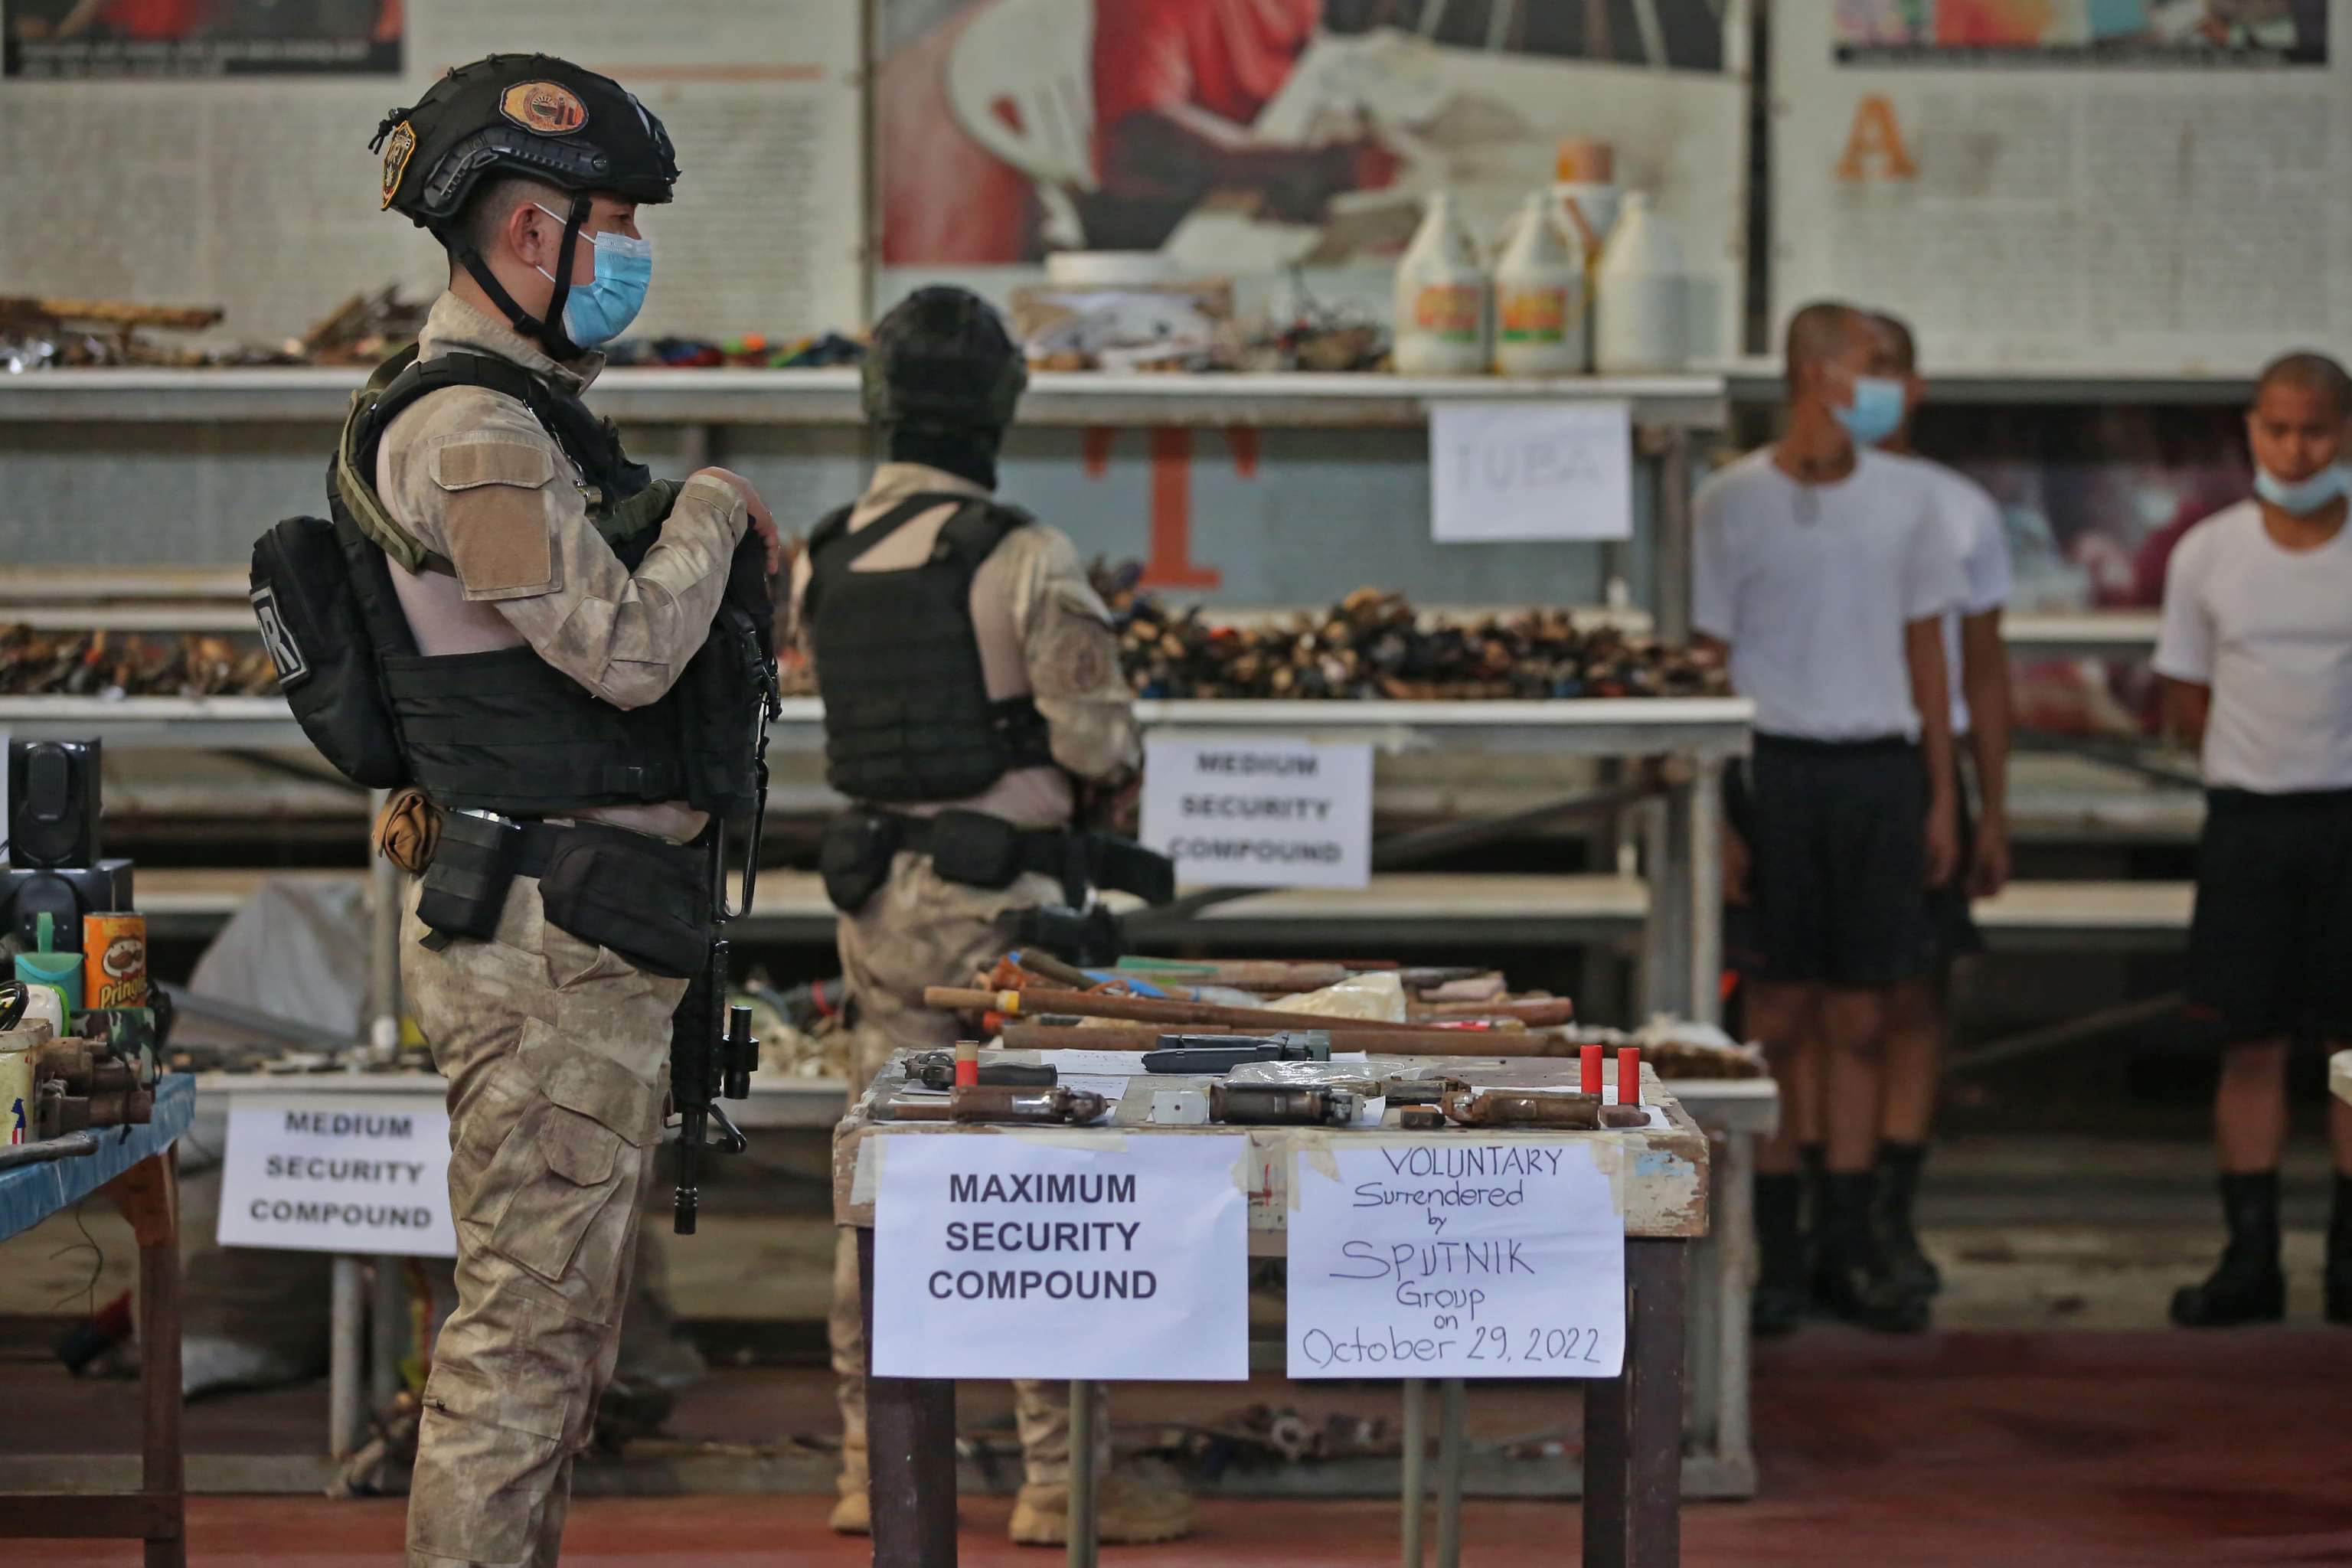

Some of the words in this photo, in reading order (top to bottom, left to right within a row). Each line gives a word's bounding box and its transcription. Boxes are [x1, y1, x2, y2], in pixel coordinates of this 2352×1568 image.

[1836, 96, 1918, 179] A
[1196, 752, 1318, 775] MEDIUM
[1181, 795, 1331, 819] SECURITY
[1169, 838, 1343, 864] COMPOUND
[285, 1112, 413, 1138] MEDIUM
[266, 1156, 423, 1184] SECURITY
[1380, 1146, 1563, 1178] VOLUNTARY
[949, 1174, 1136, 1203] MAXIMUM
[1353, 1179, 1524, 1207] Surrendered
[250, 1199, 432, 1228] COMPOUND
[1427, 1207, 1447, 1235] by
[946, 1222, 1141, 1252] SECURITY
[1329, 1238, 1535, 1282] SPUTNIK
[928, 1270, 1158, 1299] COMPOUND
[1396, 1280, 1485, 1321] Group
[1434, 1313, 1459, 1330] on
[1303, 1325, 1456, 1369] October
[1524, 1327, 1601, 1364] 2022
